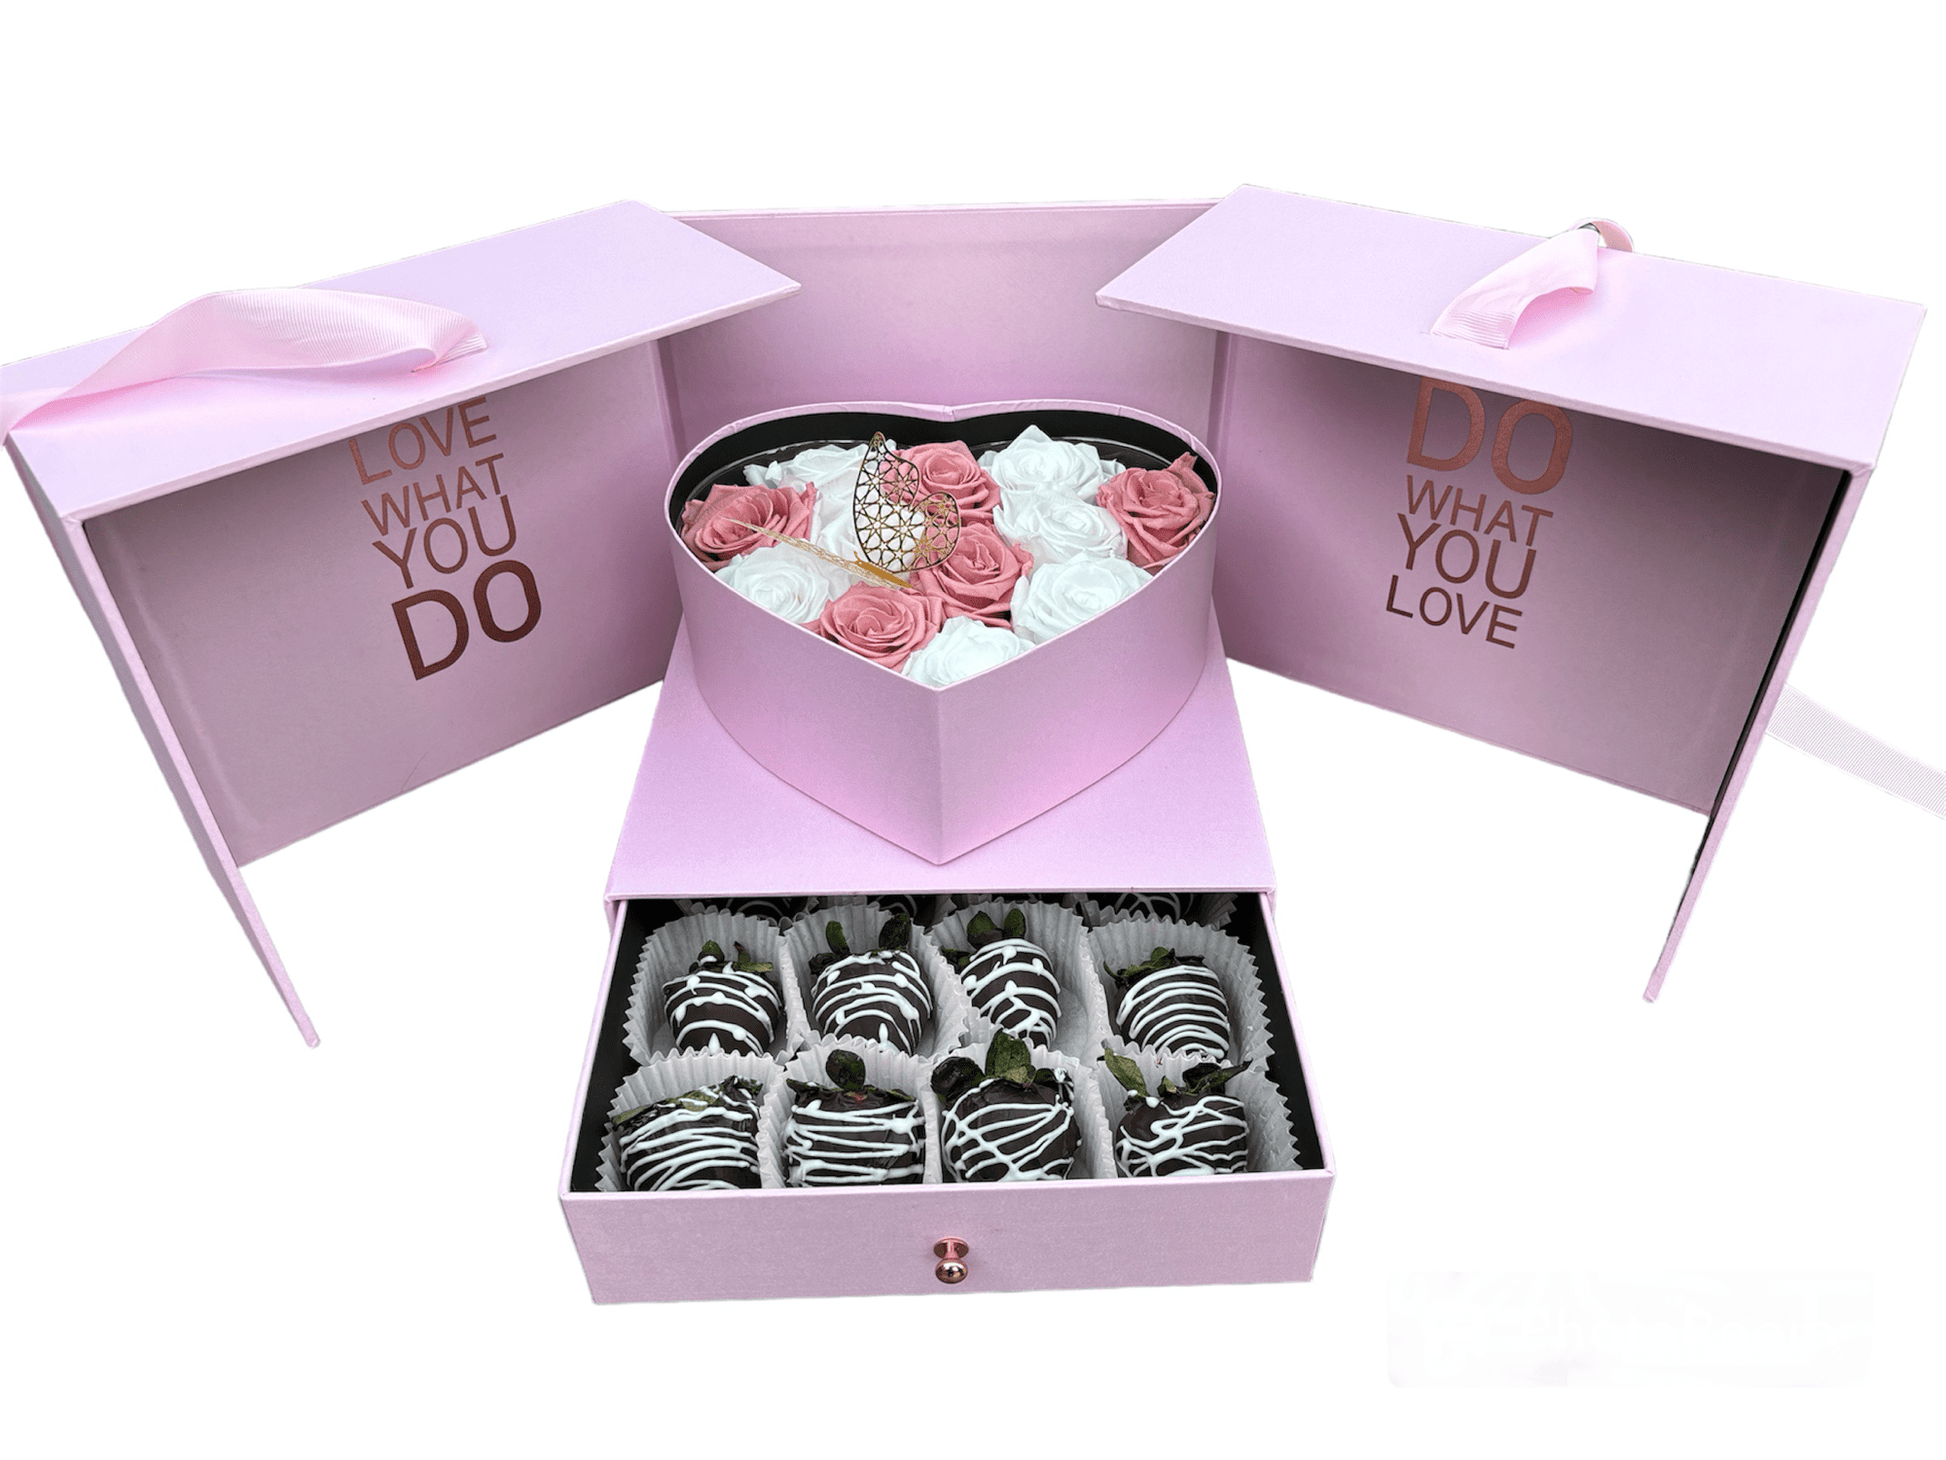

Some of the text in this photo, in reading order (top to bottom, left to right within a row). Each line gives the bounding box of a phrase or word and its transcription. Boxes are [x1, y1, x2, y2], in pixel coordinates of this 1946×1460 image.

[349, 396, 497, 485] LOVE
[1407, 375, 1573, 495] DO
[361, 453, 504, 536] WHAT
[1406, 474, 1554, 547] WHAT
[372, 495, 516, 589] YOU
[1397, 512, 1537, 599] YOU
[391, 559, 542, 681] DO
[1386, 575, 1523, 649] LOVE
